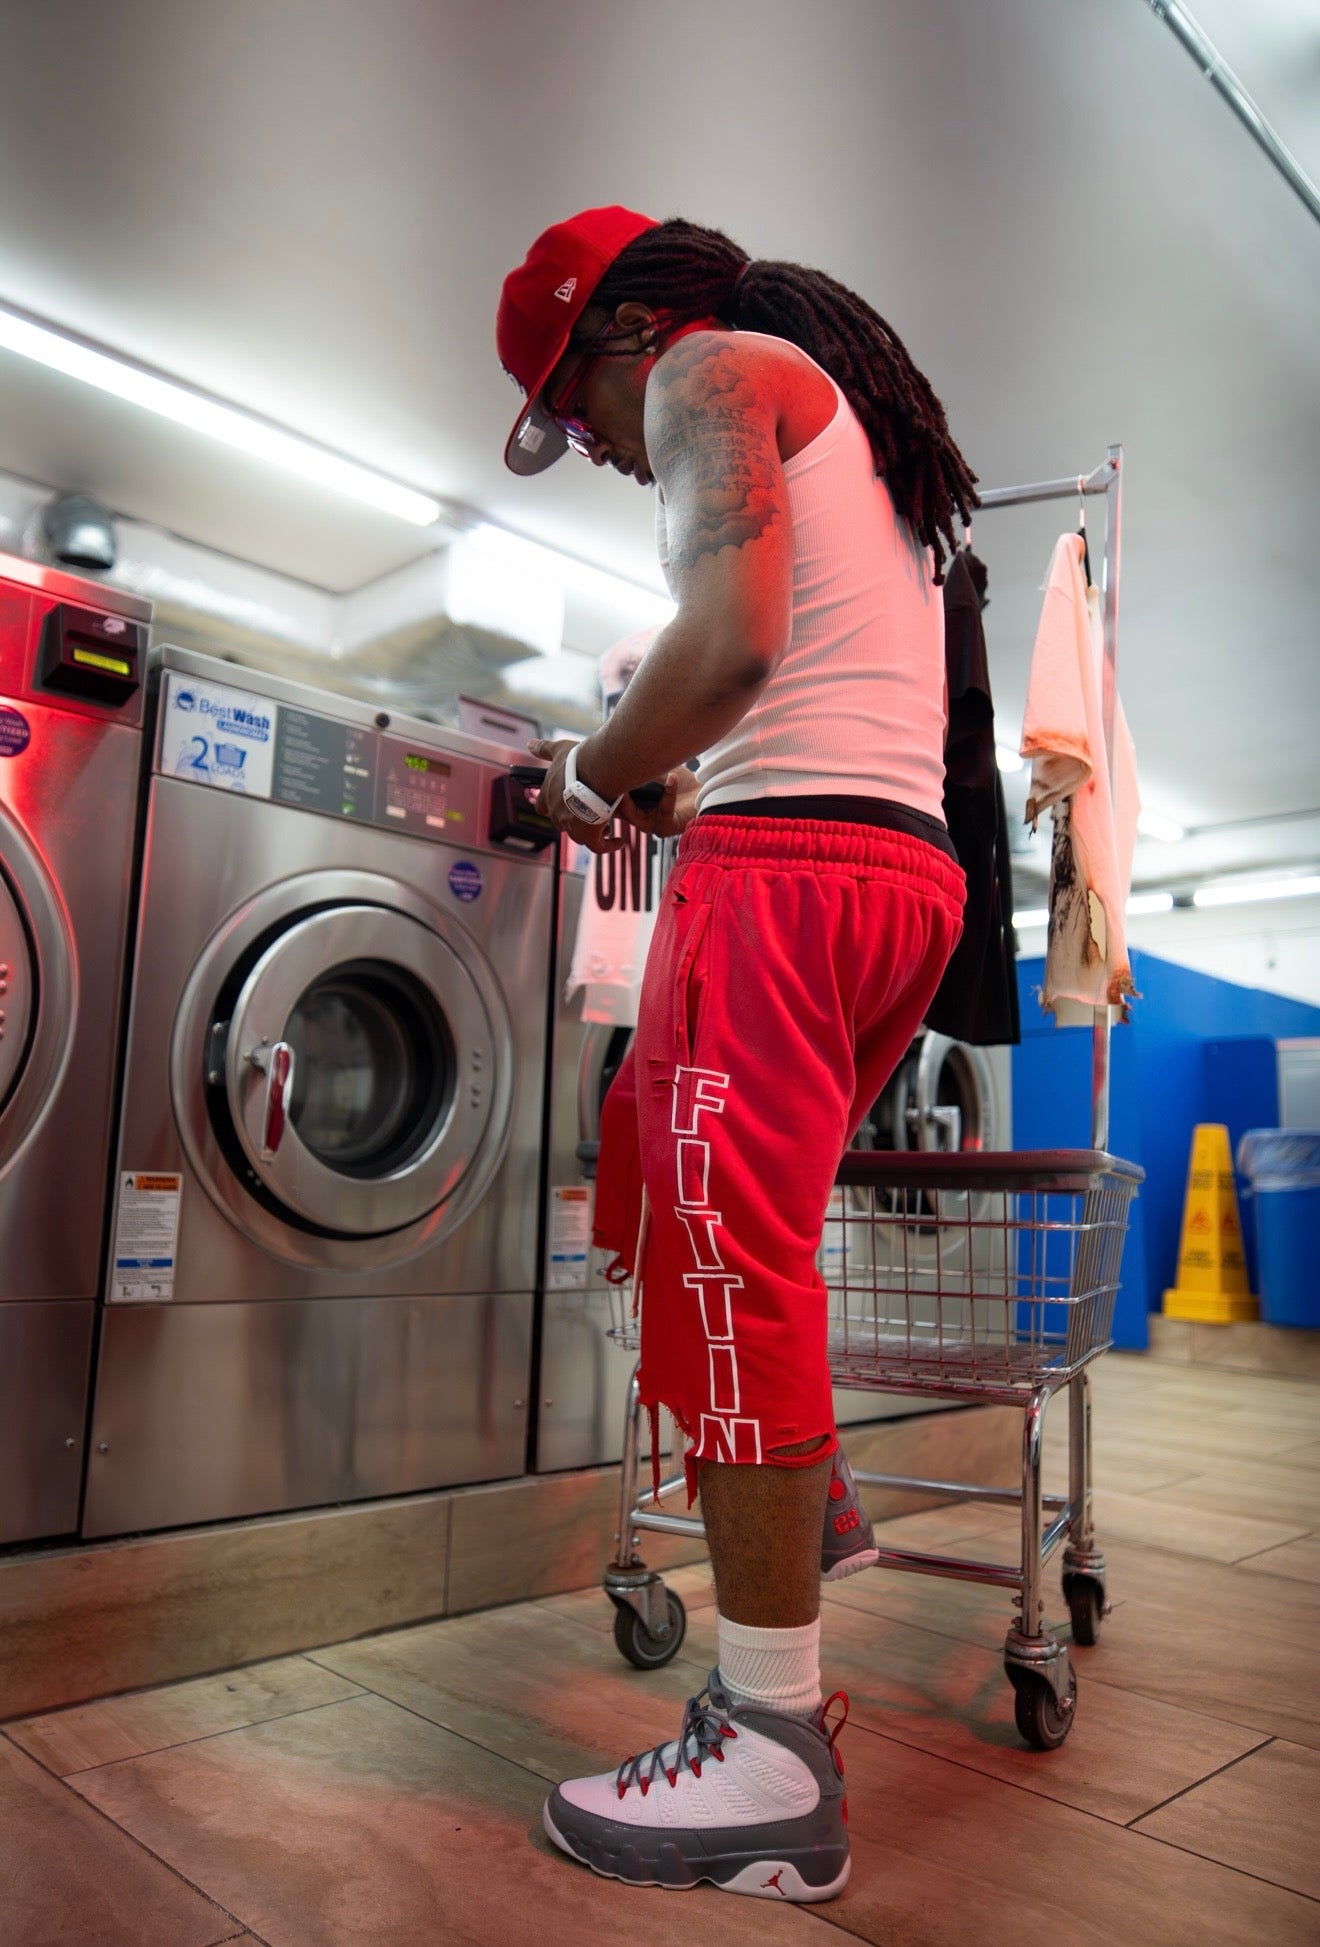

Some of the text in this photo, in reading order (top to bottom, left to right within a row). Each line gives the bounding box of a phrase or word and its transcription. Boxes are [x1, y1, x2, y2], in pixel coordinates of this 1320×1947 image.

[199, 699, 270, 730] BestWash
[191, 735, 209, 771] 2
[211, 763, 245, 780] LOADS
